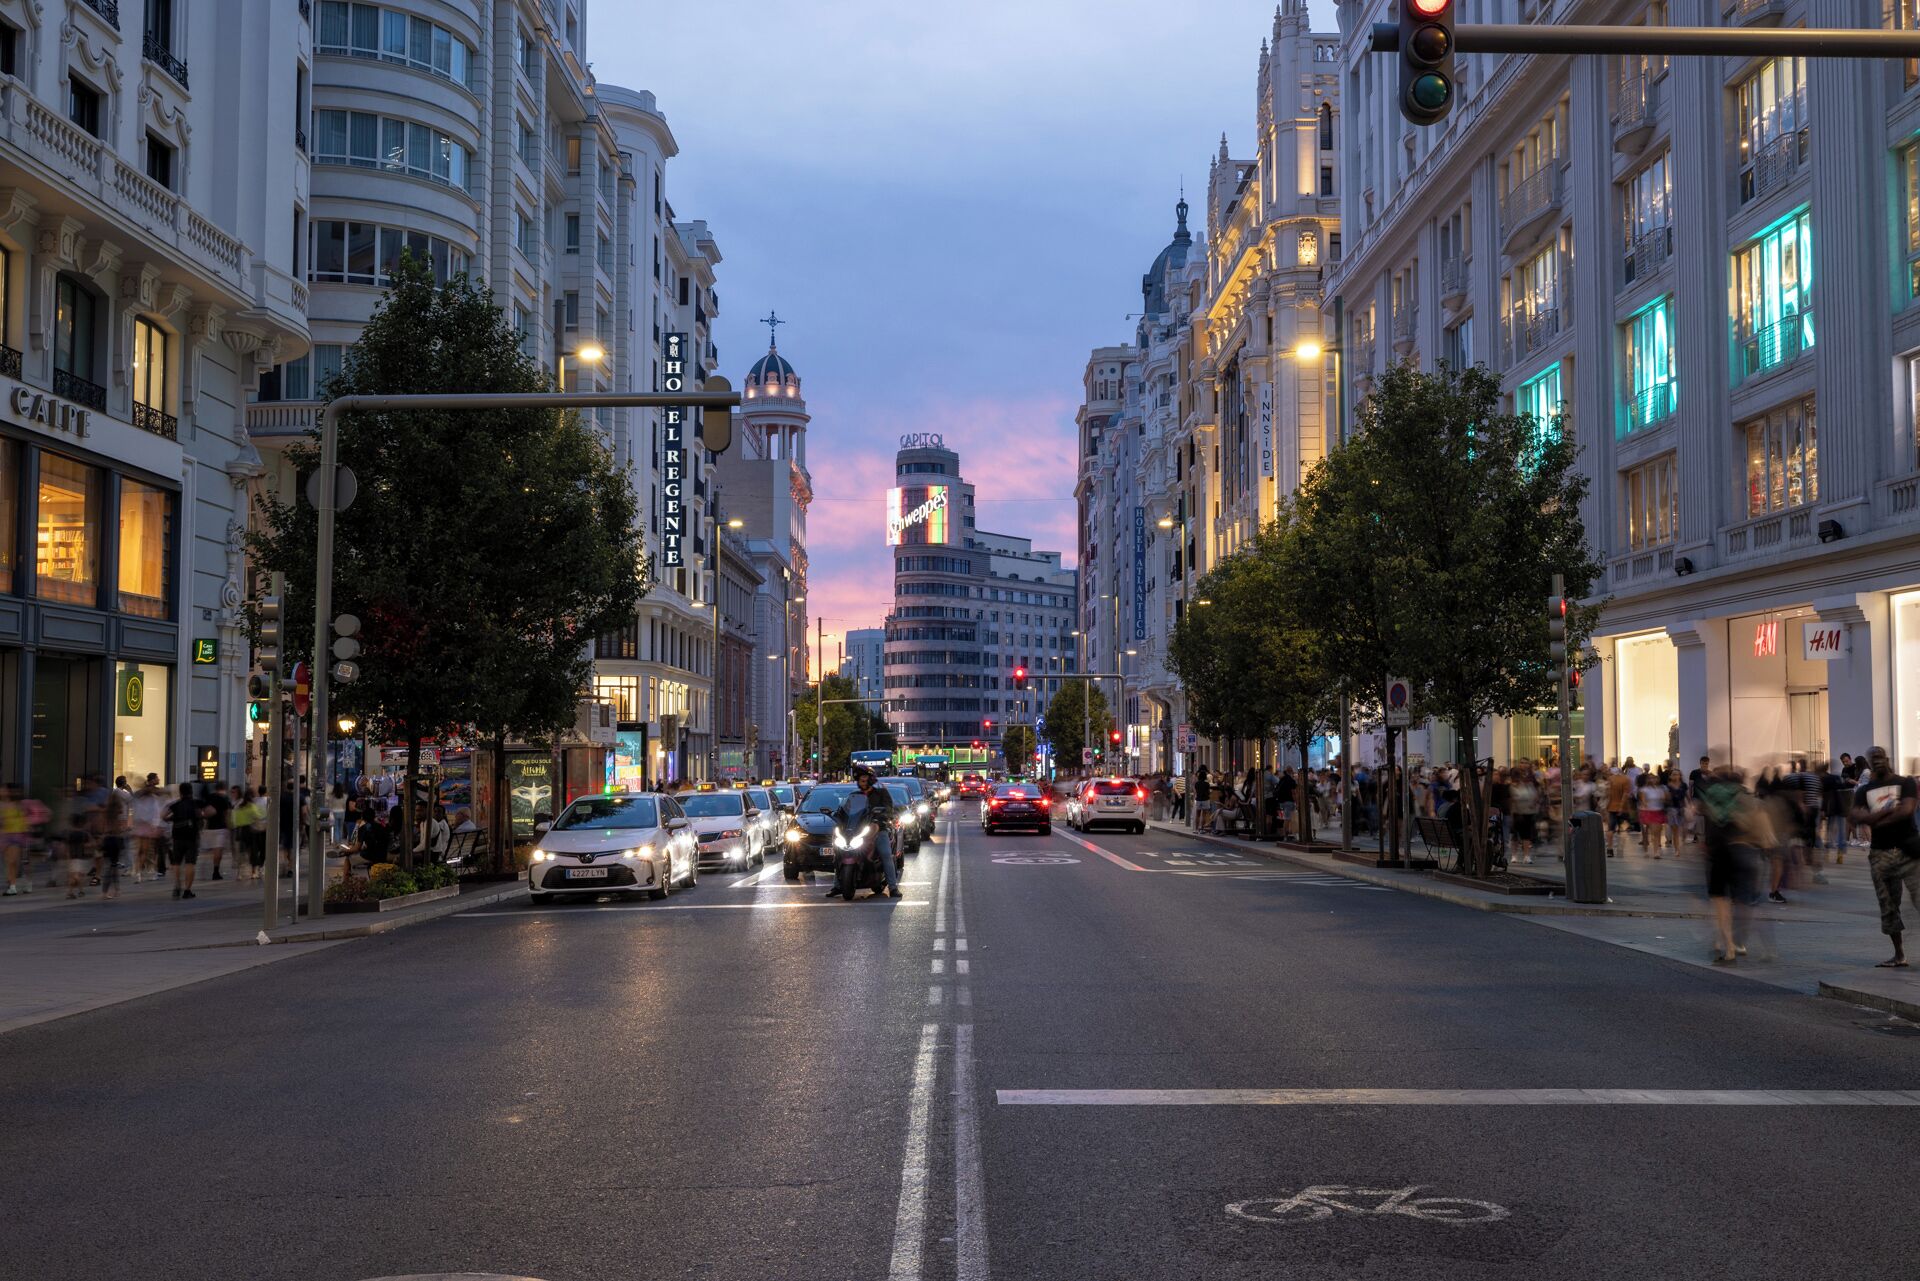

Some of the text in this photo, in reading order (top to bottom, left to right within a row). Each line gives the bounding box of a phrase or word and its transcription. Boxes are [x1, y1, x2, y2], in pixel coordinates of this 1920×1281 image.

[10, 387, 91, 438] CALPE
[665, 361, 682, 441] HOEL
[900, 432, 944, 447] CAPITOL
[665, 450, 680, 564] REGENTE
[888, 490, 947, 541] Schweppes
[1135, 508, 1143, 553] HOTEL
[1754, 621, 1777, 657] H&M
[1809, 629, 1841, 652] H&M
[572, 869, 590, 878] 4227
